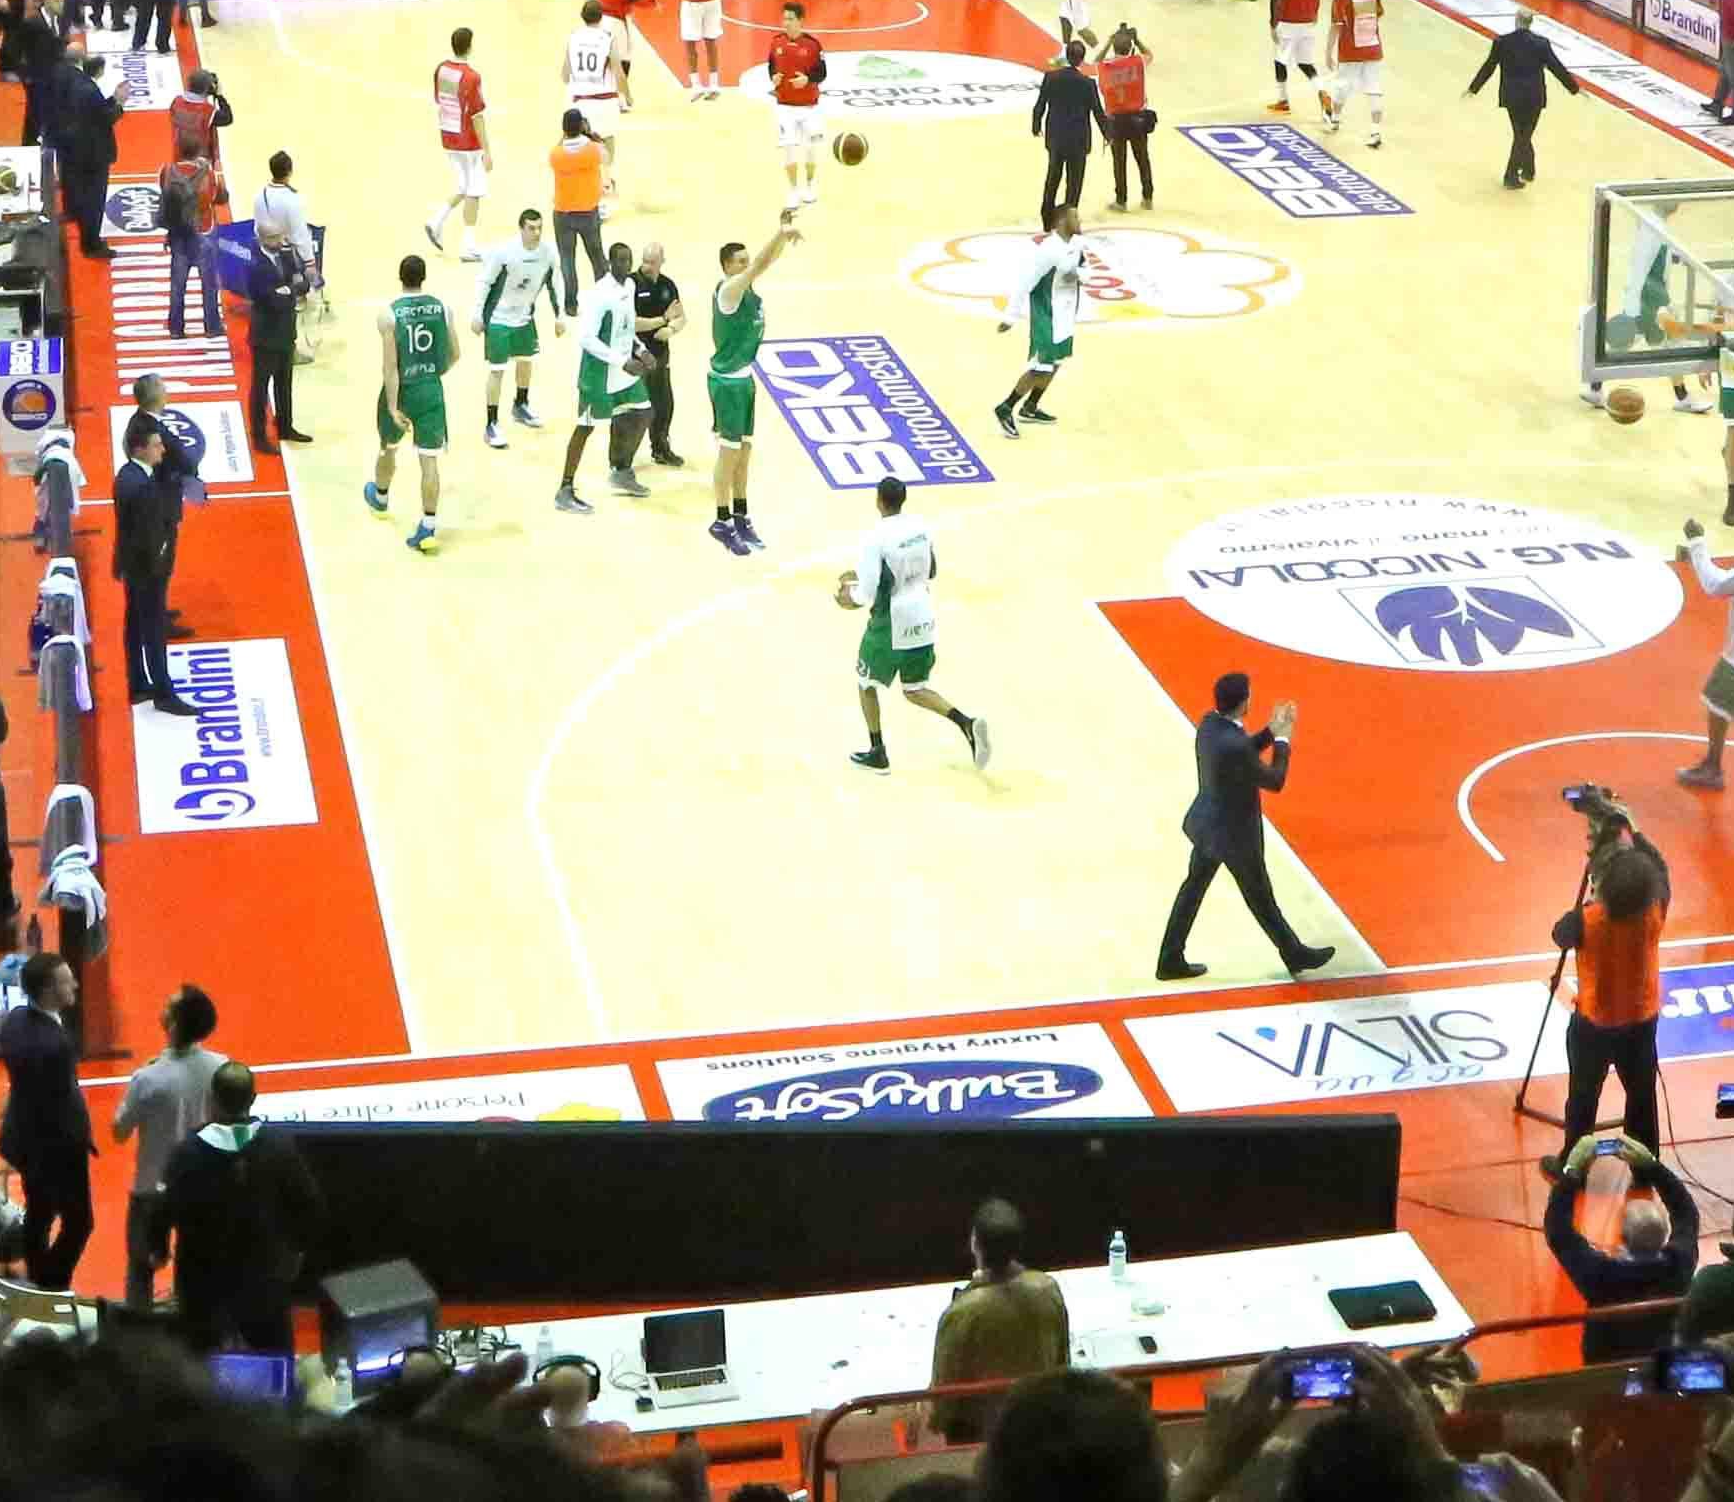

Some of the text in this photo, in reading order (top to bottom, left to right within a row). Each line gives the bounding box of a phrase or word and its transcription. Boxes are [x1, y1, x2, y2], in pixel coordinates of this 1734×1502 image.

[1661, 2, 1718, 44] Brandini
[577, 51, 598, 74] 10
[843, 97, 995, 108] Group
[1186, 126, 1364, 217] BEKO
[406, 324, 432, 354] 16
[767, 338, 926, 487] BEKO
[1187, 539, 1636, 589] N.G. NICCOLAI
[169, 646, 249, 787] Brandini
[706, 1030, 1059, 1072] Luxury Hygiene Solutions
[1216, 1009, 1509, 1079] SILVA
[409, 1090, 528, 1118] Persone
[734, 1060, 1080, 1122] BulkySoft
